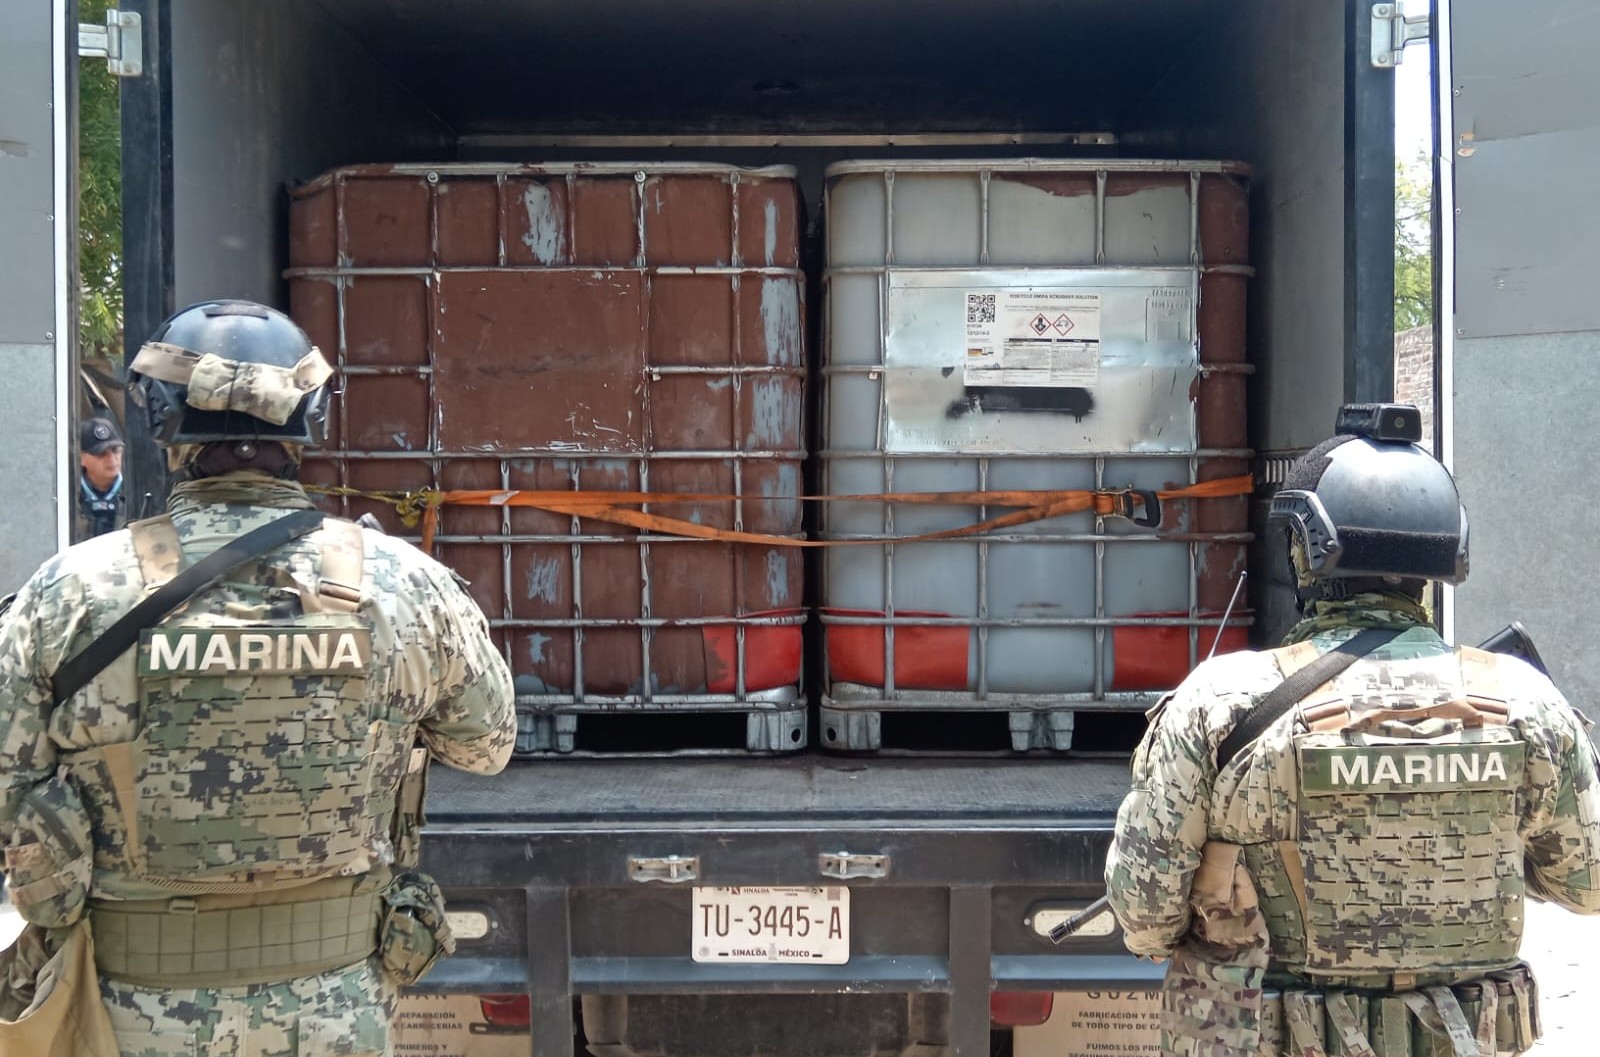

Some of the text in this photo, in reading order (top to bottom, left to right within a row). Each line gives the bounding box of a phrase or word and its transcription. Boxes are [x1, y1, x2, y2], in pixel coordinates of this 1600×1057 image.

[150, 633, 363, 671] MARINA
[1330, 752, 1508, 785] MARINA
[700, 904, 842, 939] TU-3445-A
[732, 948, 810, 958] SINALOA MÉXICO
[1086, 1022, 1110, 1030] TODO
[1086, 1043, 1121, 1051] FUIMOS
[1123, 1044, 1140, 1052] LOS
